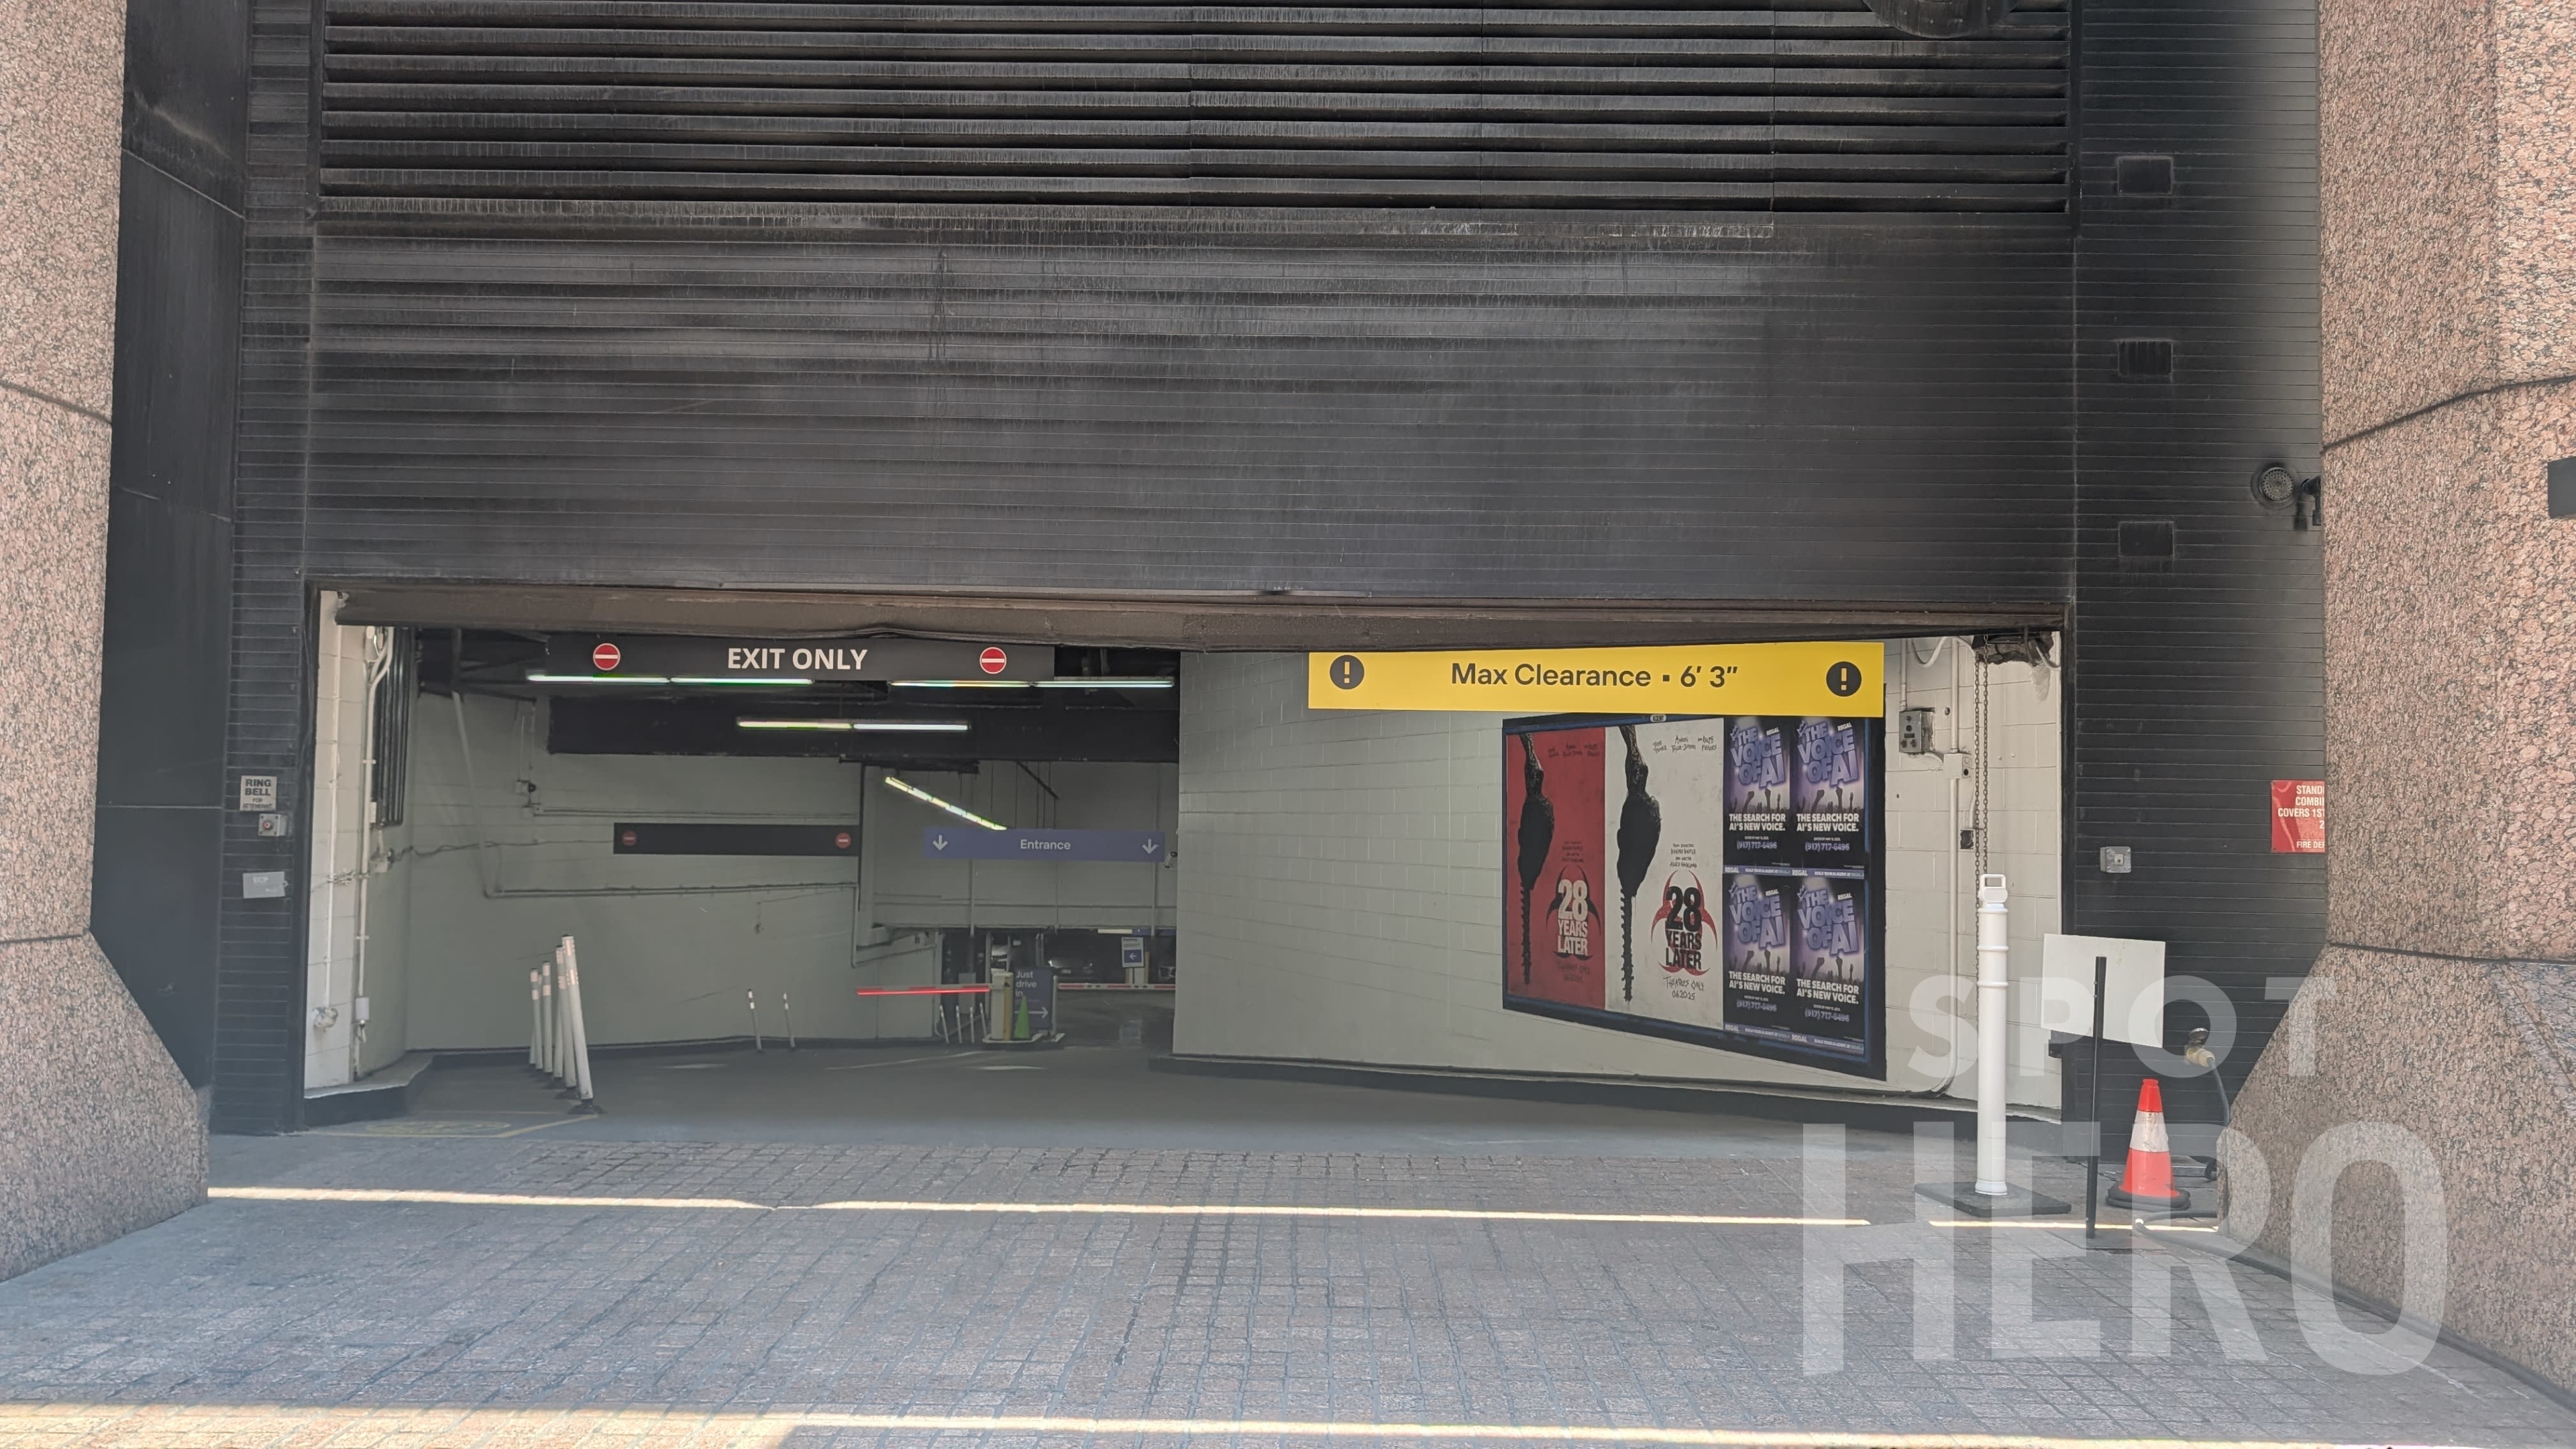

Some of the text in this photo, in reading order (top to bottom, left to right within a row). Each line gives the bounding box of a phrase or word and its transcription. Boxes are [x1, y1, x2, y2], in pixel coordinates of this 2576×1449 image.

[728, 648, 868, 669] EXIT ONLY
[1451, 663, 1508, 685] Max
[1514, 663, 1652, 686] Clearance
[1766, 727, 1780, 735] REGAL
[1805, 721, 1828, 742] THE
[1837, 722, 1852, 731] REGAL
[1736, 727, 1758, 746] THE
[1731, 733, 1782, 766] VOICE
[1798, 729, 1855, 764] VOICE
[1739, 753, 1784, 788] OF AI
[1807, 749, 1859, 786] OF AI
[246, 779, 272, 787] RING
[2296, 785, 2324, 794] STAND
[245, 788, 271, 796] BELL
[2295, 796, 2324, 806] COMBI
[1729, 813, 1786, 822] THE SEARCH FOR
[1796, 813, 1860, 822] THE SEARCH FOR
[2277, 808, 2310, 817] COVERS
[1729, 822, 1786, 831] AI'S NEW VOICE.
[1796, 822, 1859, 832] AI'S NEW VOICE.
[1020, 839, 1071, 850] Entrance
[1805, 843, 1820, 851] (917)
[1558, 879, 1588, 922] 28
[1735, 885, 1758, 904] THE
[1804, 890, 1828, 908] THE
[1837, 892, 1852, 900] REGAL
[1665, 885, 1703, 932] 28
[1729, 896, 1781, 924] VOICE
[1798, 899, 1855, 929] VOICE
[1558, 919, 1588, 938] YEARS
[1737, 916, 1784, 949] OF AI
[1558, 935, 1588, 956] LATER
[1665, 929, 1702, 951] YEARS
[1807, 921, 1859, 955] OF AI
[1666, 947, 1702, 970] LATER
[1016, 971, 1033, 979] Just
[1729, 971, 1786, 985] THE SEARCH FOR
[1015, 989, 1023, 997] in
[1729, 980, 1786, 995] AI'S NEW VOICE.
[1796, 978, 1860, 995] THE SEARCH FOR
[1796, 988, 1859, 1004] AI'S NEW VOICE.
